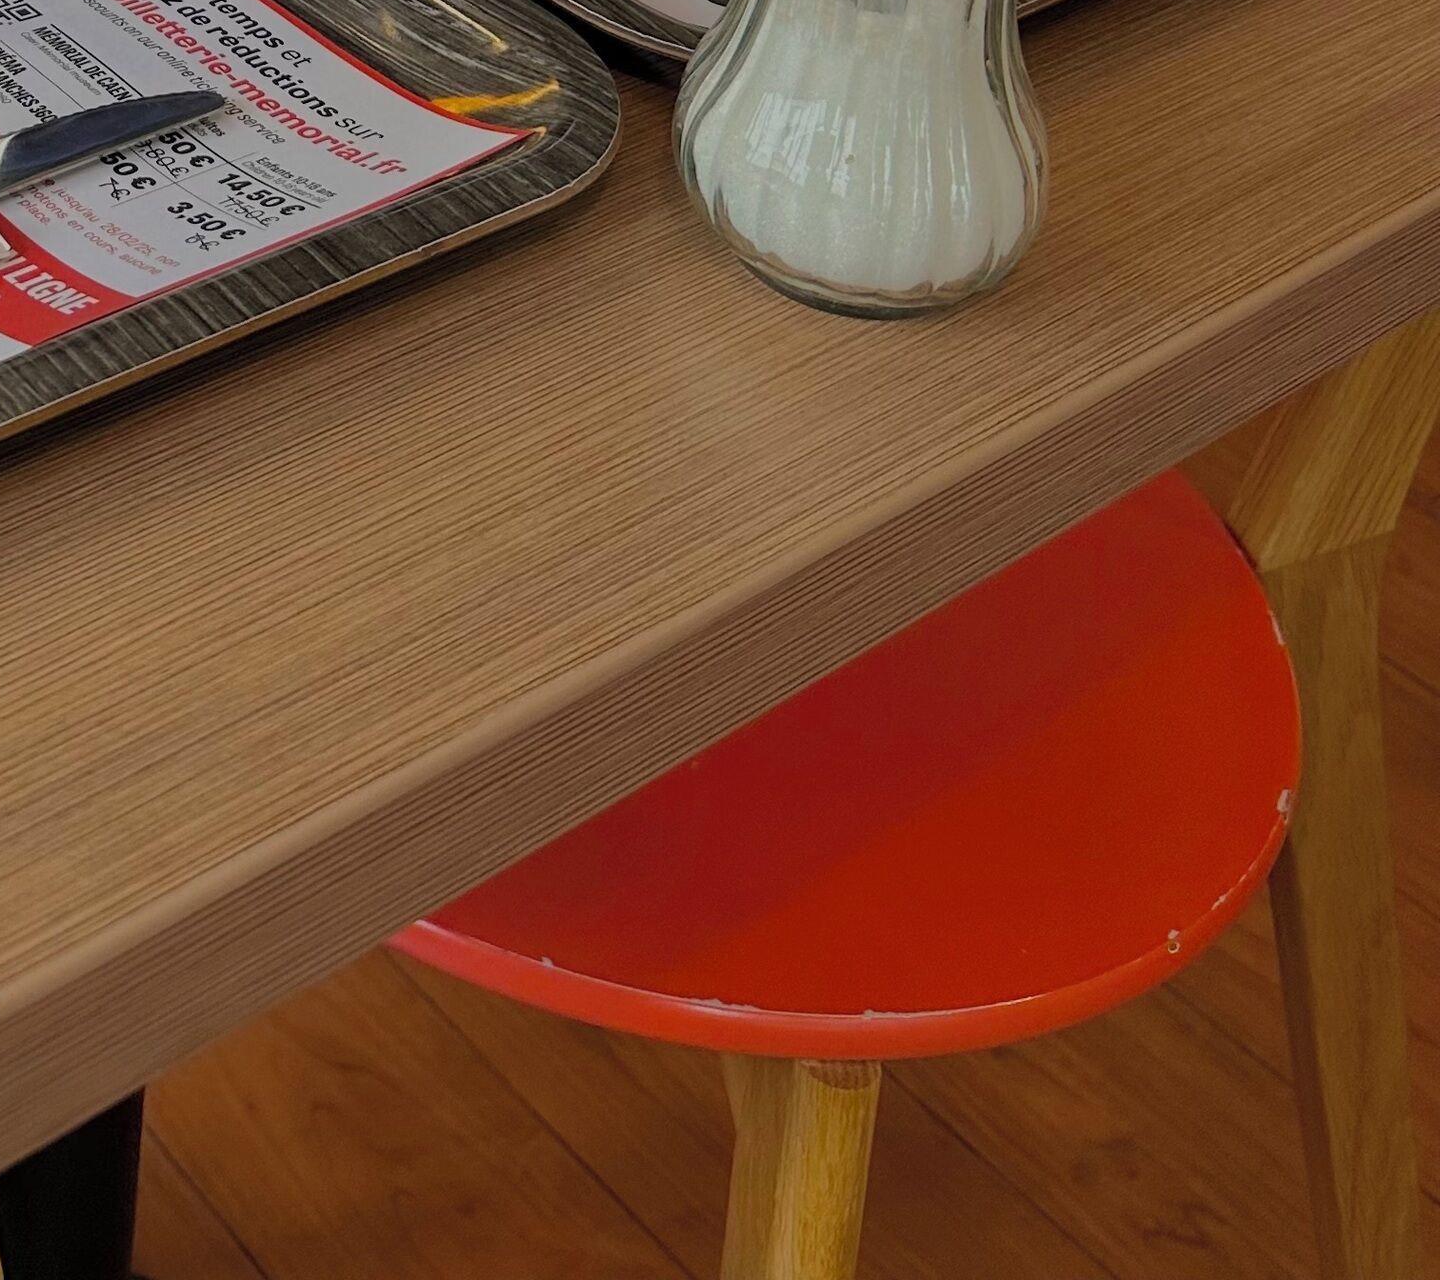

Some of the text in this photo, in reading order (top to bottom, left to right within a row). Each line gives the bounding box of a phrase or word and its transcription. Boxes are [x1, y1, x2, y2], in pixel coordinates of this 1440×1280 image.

[32, 25, 134, 101] MÉMORIAL DE CAEN
[176, 6, 211, 26] de
[206, 25, 339, 118] réductions
[334, 117, 385, 141] sur
[281, 49, 312, 68] et
[123, 24, 144, 39] on
[136, 34, 163, 51] our
[157, 49, 194, 78] online
[237, 114, 287, 145] service
[256, 156, 295, 180] Enfants
[53, 184, 101, 224] jusqu'au
[218, 172, 287, 208] 14,50
[66, 220, 85, 233] en
[167, 201, 227, 232] 3,50
[2, 264, 100, 316] LIGNE
